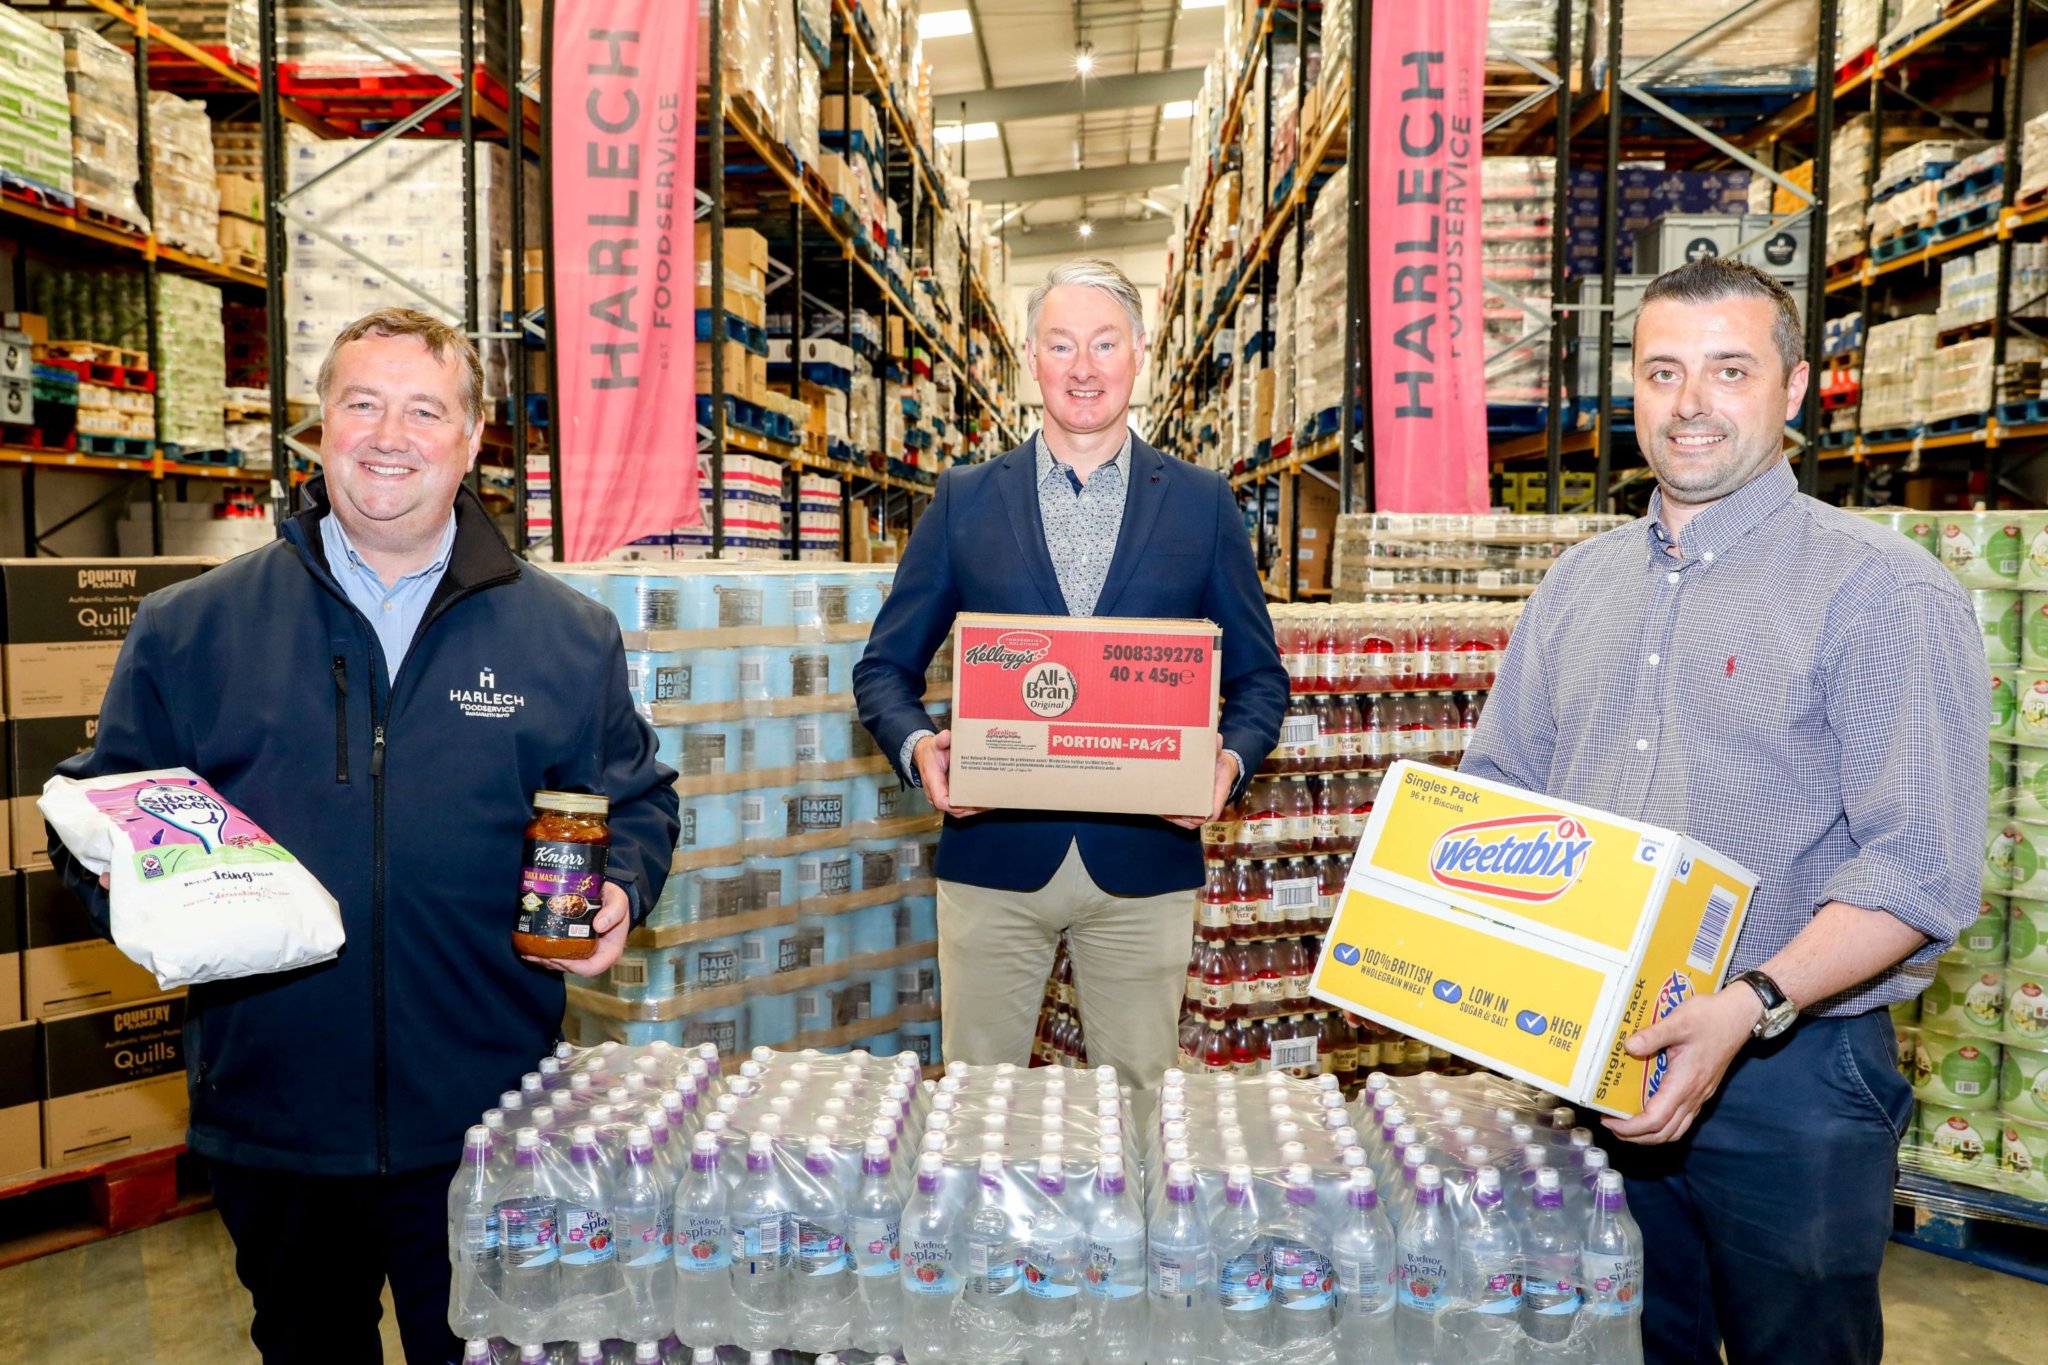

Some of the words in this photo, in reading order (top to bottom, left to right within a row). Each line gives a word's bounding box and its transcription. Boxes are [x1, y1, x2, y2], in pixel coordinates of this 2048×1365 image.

[586, 28, 640, 390] HARLECH
[653, 92, 679, 328] FOODSERVICE
[1393, 50, 1445, 419] HARLECH
[78, 570, 136, 588] COUNTRY
[966, 644, 1034, 670] Kellogg's
[1103, 645, 1204, 663] 5008339278
[1109, 666, 1130, 682] 40
[1135, 671, 1144, 682] x
[450, 690, 524, 706] HARLECH
[1027, 682, 1069, 699] Bran
[461, 703, 515, 712] FOODSERVICE
[1031, 700, 1065, 710] Original
[1405, 773, 1447, 794] Singles
[1451, 786, 1480, 804] Pack
[802, 800, 841, 811] BAKED
[1410, 791, 1420, 799] 96
[1433, 798, 1464, 813] Biscuits
[802, 812, 841, 824] BEANS
[535, 846, 585, 865] Knorr
[1435, 826, 1593, 877] Weetabix
[1641, 846, 1656, 861] C
[537, 862, 579, 870] PROFESSIONAL
[1680, 860, 1690, 875] C
[212, 870, 253, 882] Icing
[1360, 965, 1402, 988] WHOLEGRAIN
[1403, 980, 1426, 996] WHEAT
[1468, 986, 1491, 1007] LOW
[1494, 995, 1509, 1013] IN
[114, 1004, 170, 1032] COUNTRY
[1459, 1002, 1482, 1019] SUGAR
[1483, 1011, 1491, 1020] &
[1491, 1014, 1508, 1028] SALT
[1550, 1016, 1582, 1040] HIGH
[1549, 1035, 1572, 1052] FIBRE
[1596, 1034, 1626, 1100] Singles
[1623, 978, 1646, 1024] Pack
[1613, 1072, 1622, 1086] 96
[1631, 999, 1648, 1036] scuits
[114, 1042, 176, 1069] Quills
[686, 1224, 727, 1240] splash
[689, 1218, 722, 1228] Radnor
[914, 1241, 949, 1250] Radnor
[910, 1249, 952, 1262] splash
